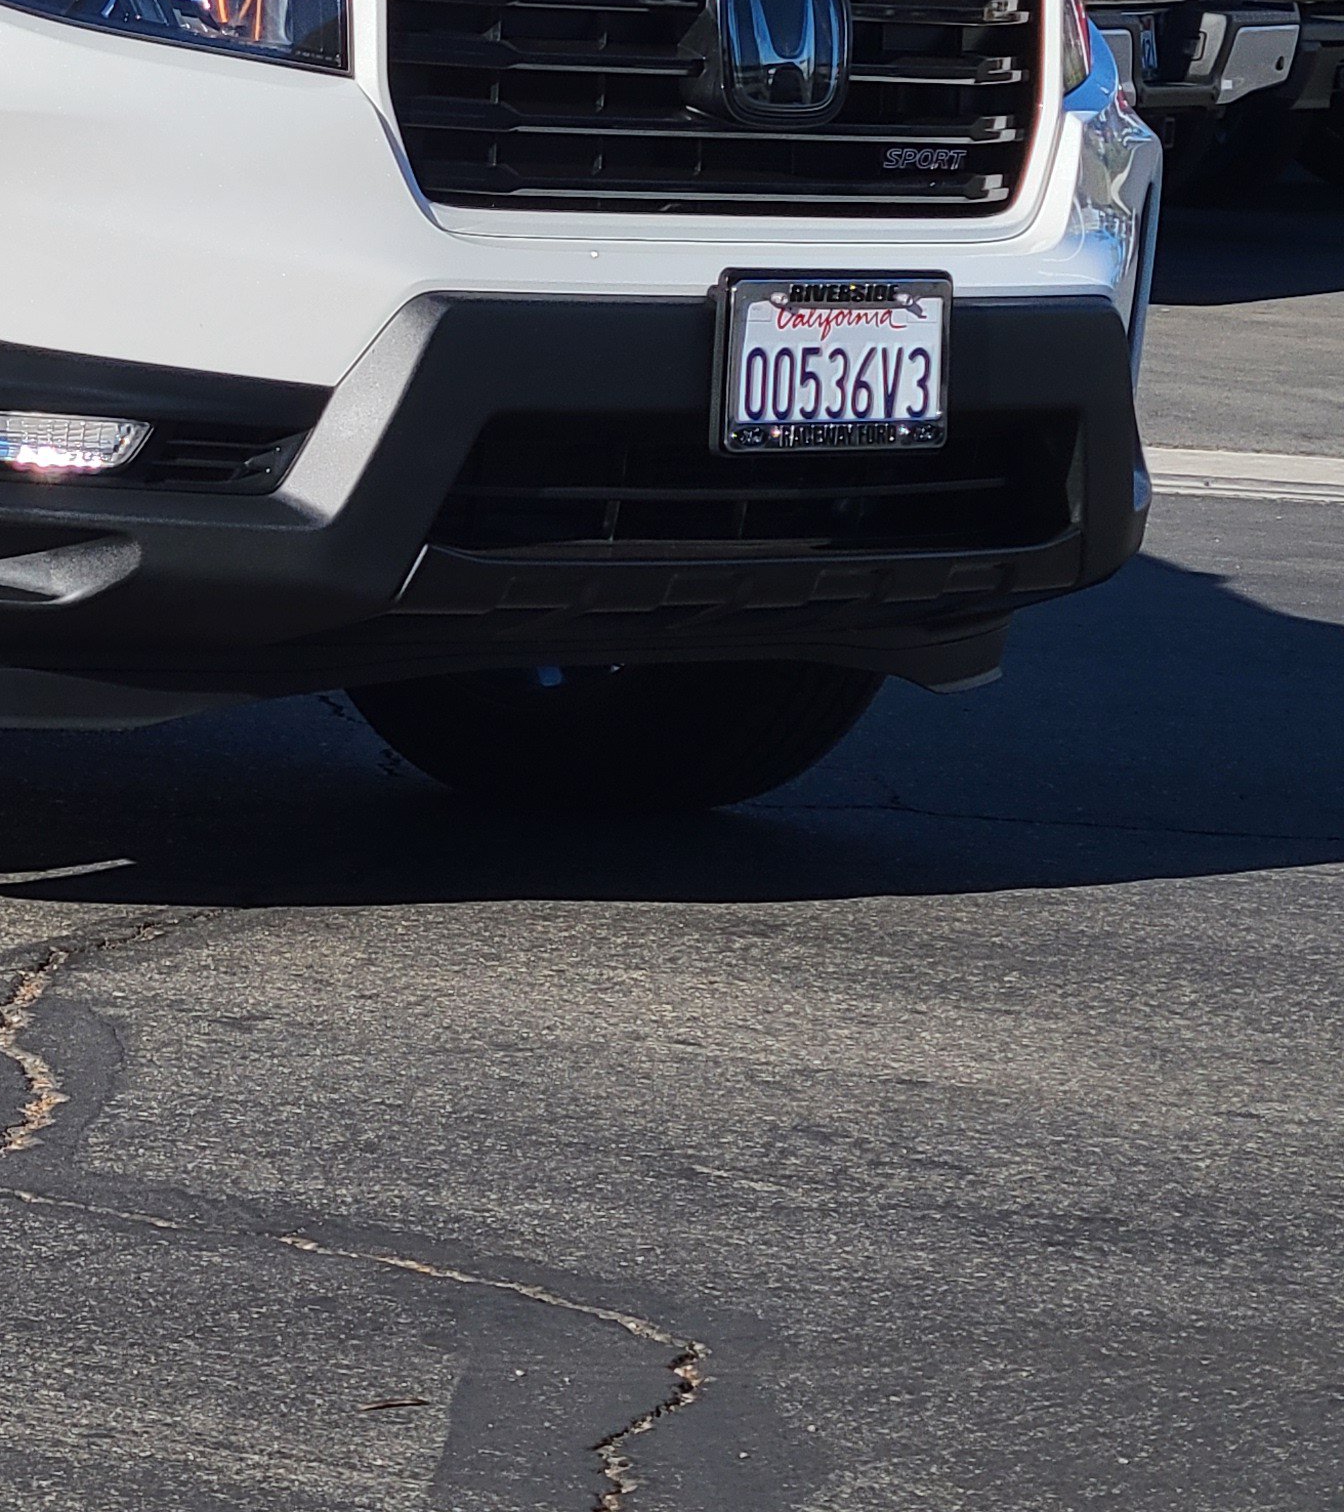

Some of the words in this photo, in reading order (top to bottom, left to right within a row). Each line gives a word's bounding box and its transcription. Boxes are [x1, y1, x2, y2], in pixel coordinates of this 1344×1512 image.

[883, 148, 967, 170] SPORT
[789, 284, 899, 302] RIVERSIDE
[776, 306, 908, 341] California
[744, 346, 931, 420] 00536V3
[778, 424, 854, 447] RACEWAY
[857, 424, 897, 445] FORD
